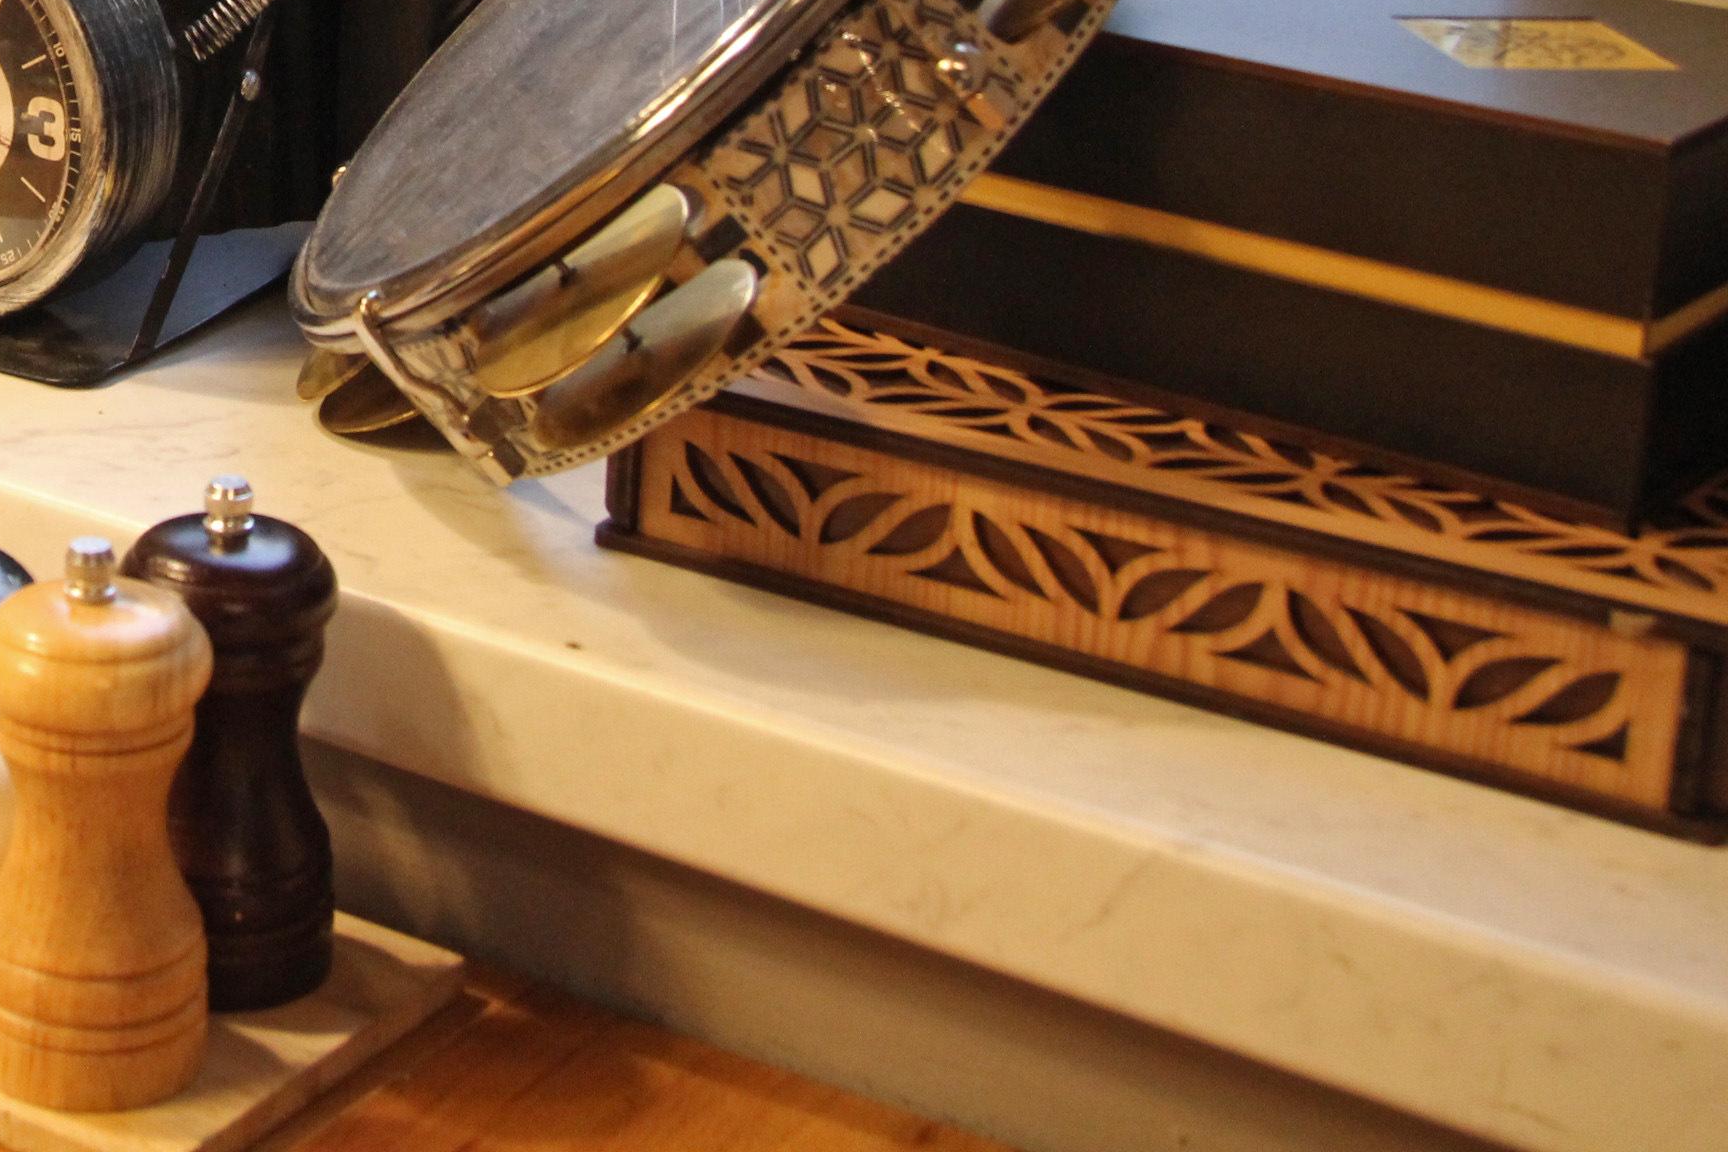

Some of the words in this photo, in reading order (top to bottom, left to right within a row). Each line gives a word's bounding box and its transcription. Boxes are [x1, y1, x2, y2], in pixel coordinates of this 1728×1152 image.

[52, 43, 65, 58] 10
[27, 95, 66, 162] 3
[71, 127, 83, 144] 15
[0, 249, 17, 265] 25
